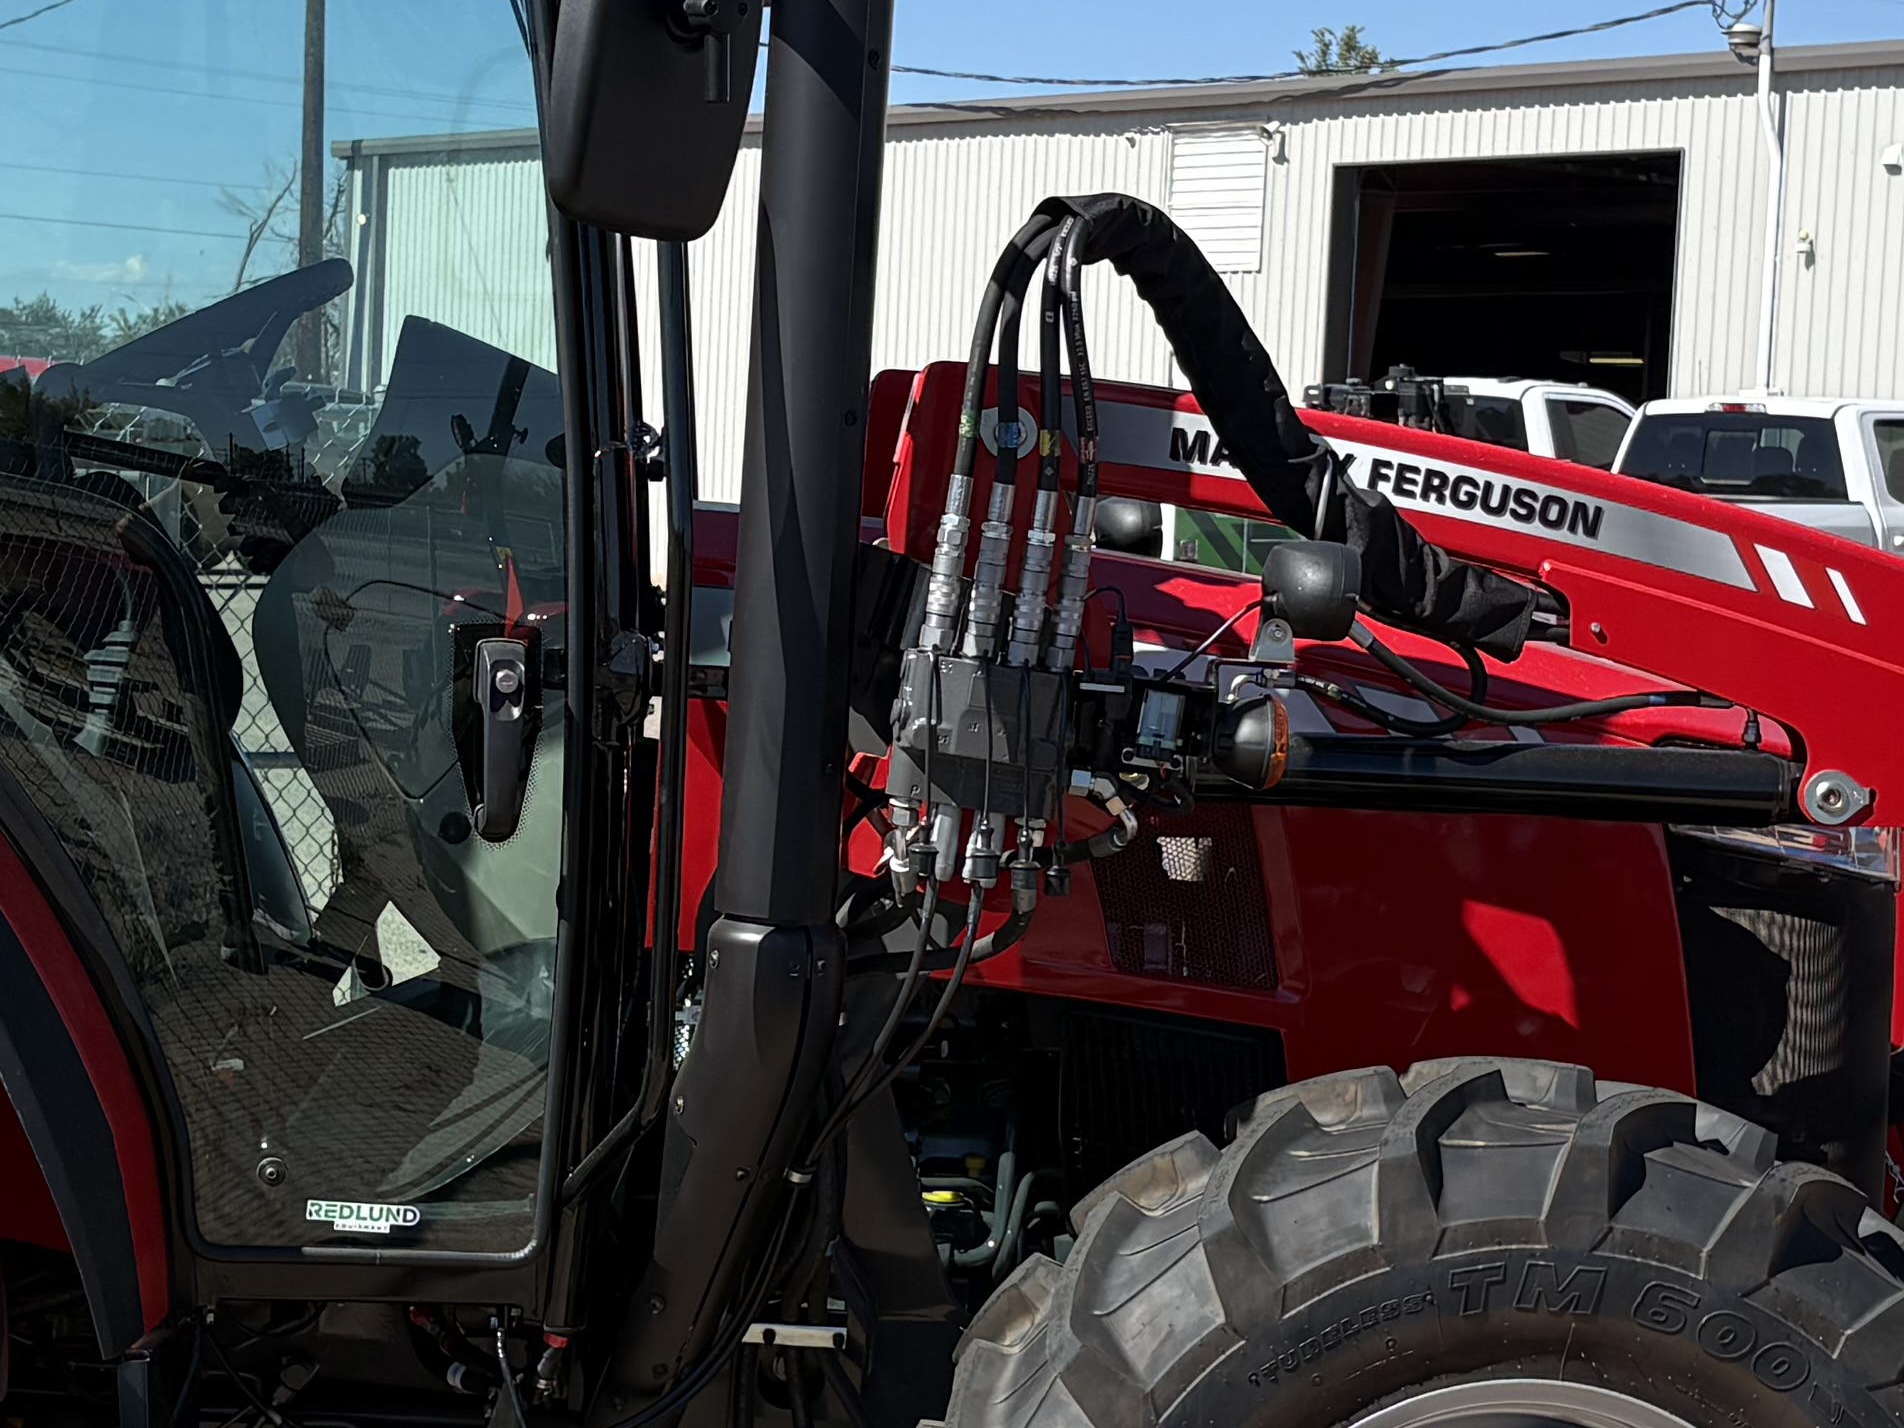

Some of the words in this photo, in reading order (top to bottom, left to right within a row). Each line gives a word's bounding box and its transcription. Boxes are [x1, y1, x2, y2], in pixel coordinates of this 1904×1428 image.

[1367, 458, 1604, 540] FERGUSON
[308, 1202, 418, 1223] REDLUND
[1447, 1260, 1608, 1317] TM
[1633, 1281, 1812, 1394] 600
